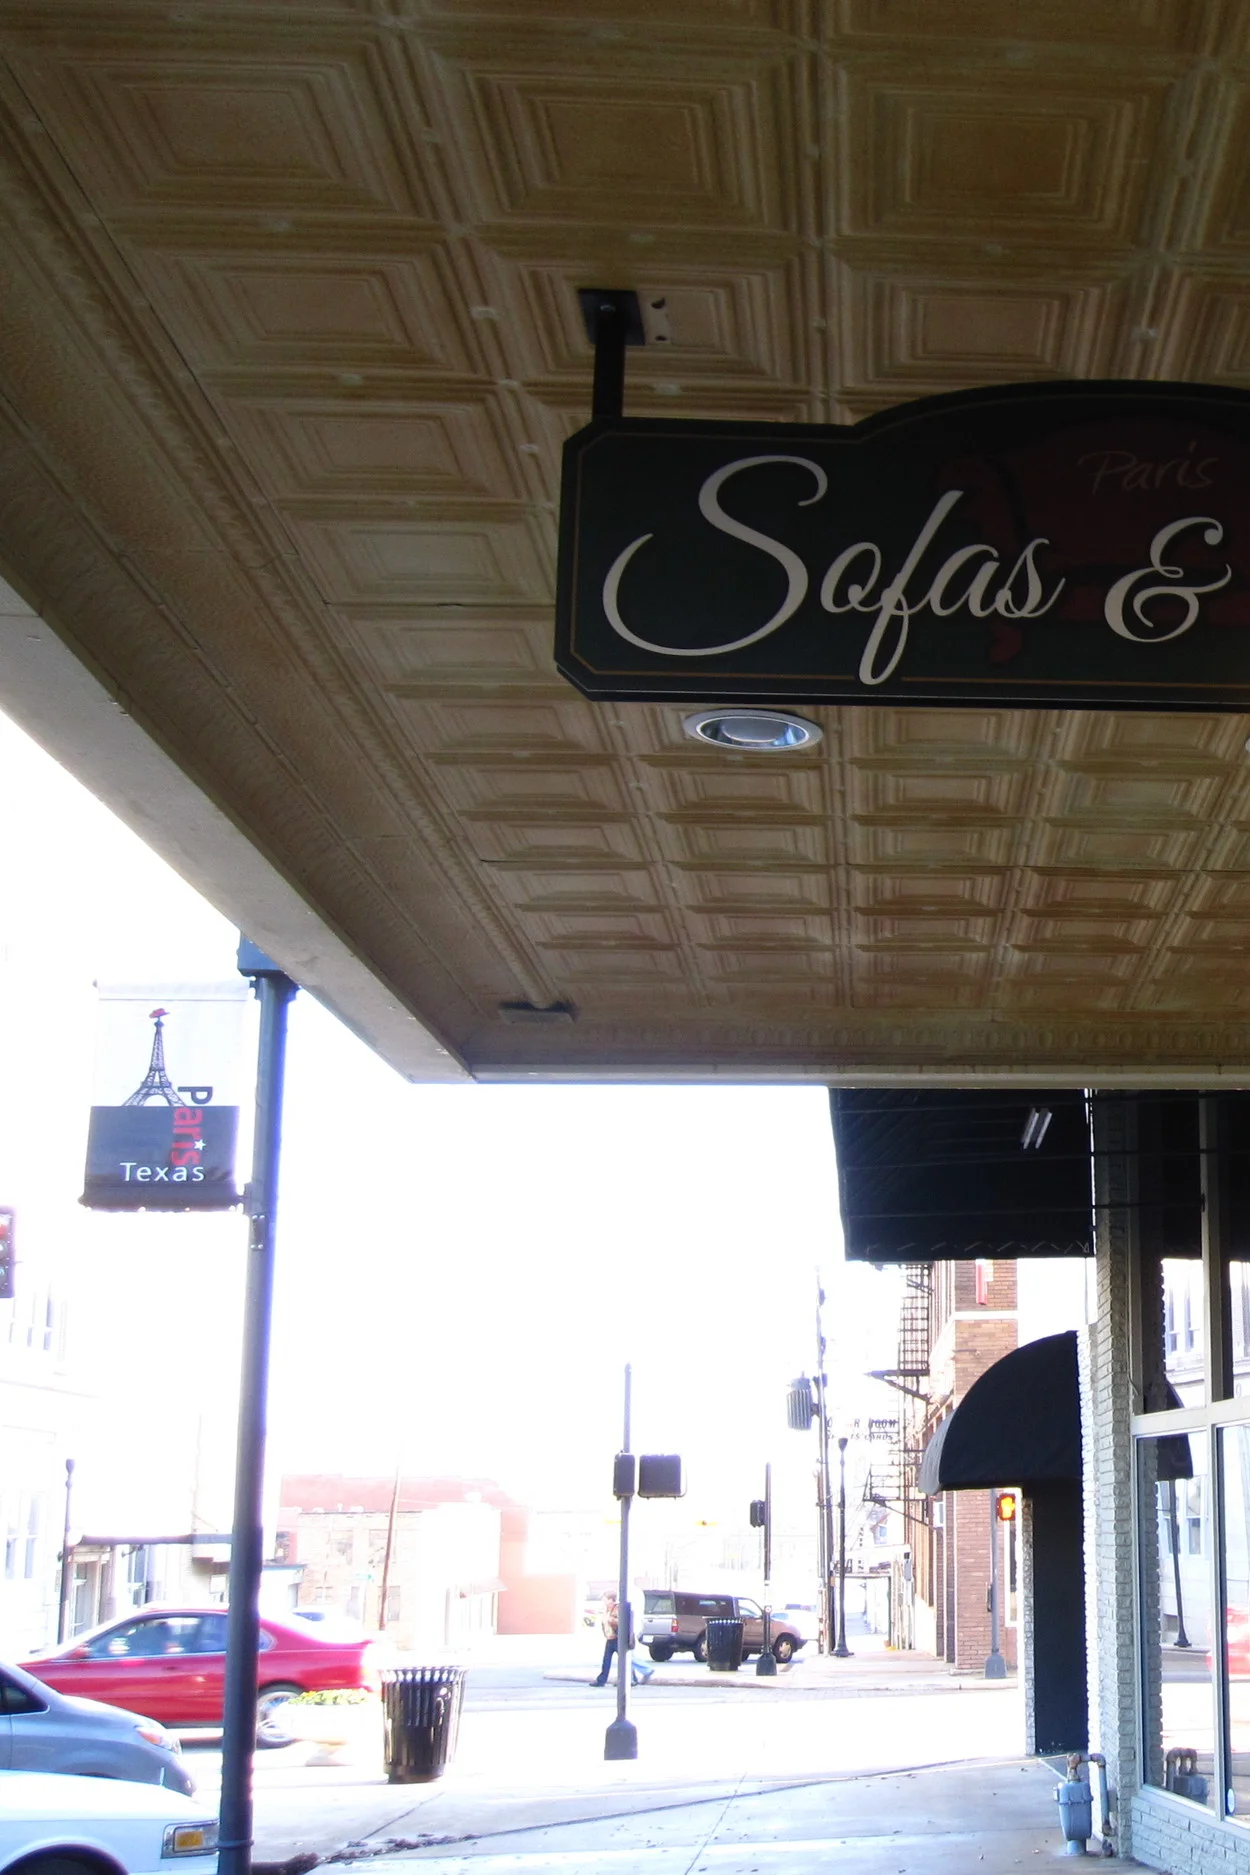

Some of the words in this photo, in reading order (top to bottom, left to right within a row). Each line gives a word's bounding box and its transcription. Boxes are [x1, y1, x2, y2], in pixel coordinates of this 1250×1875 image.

[1077, 440, 1219, 497] Paris
[602, 456, 1066, 686] Sofas
[1104, 516, 1232, 643] &
[170, 1085, 213, 1166] Paris
[119, 1161, 205, 1182] Texas
